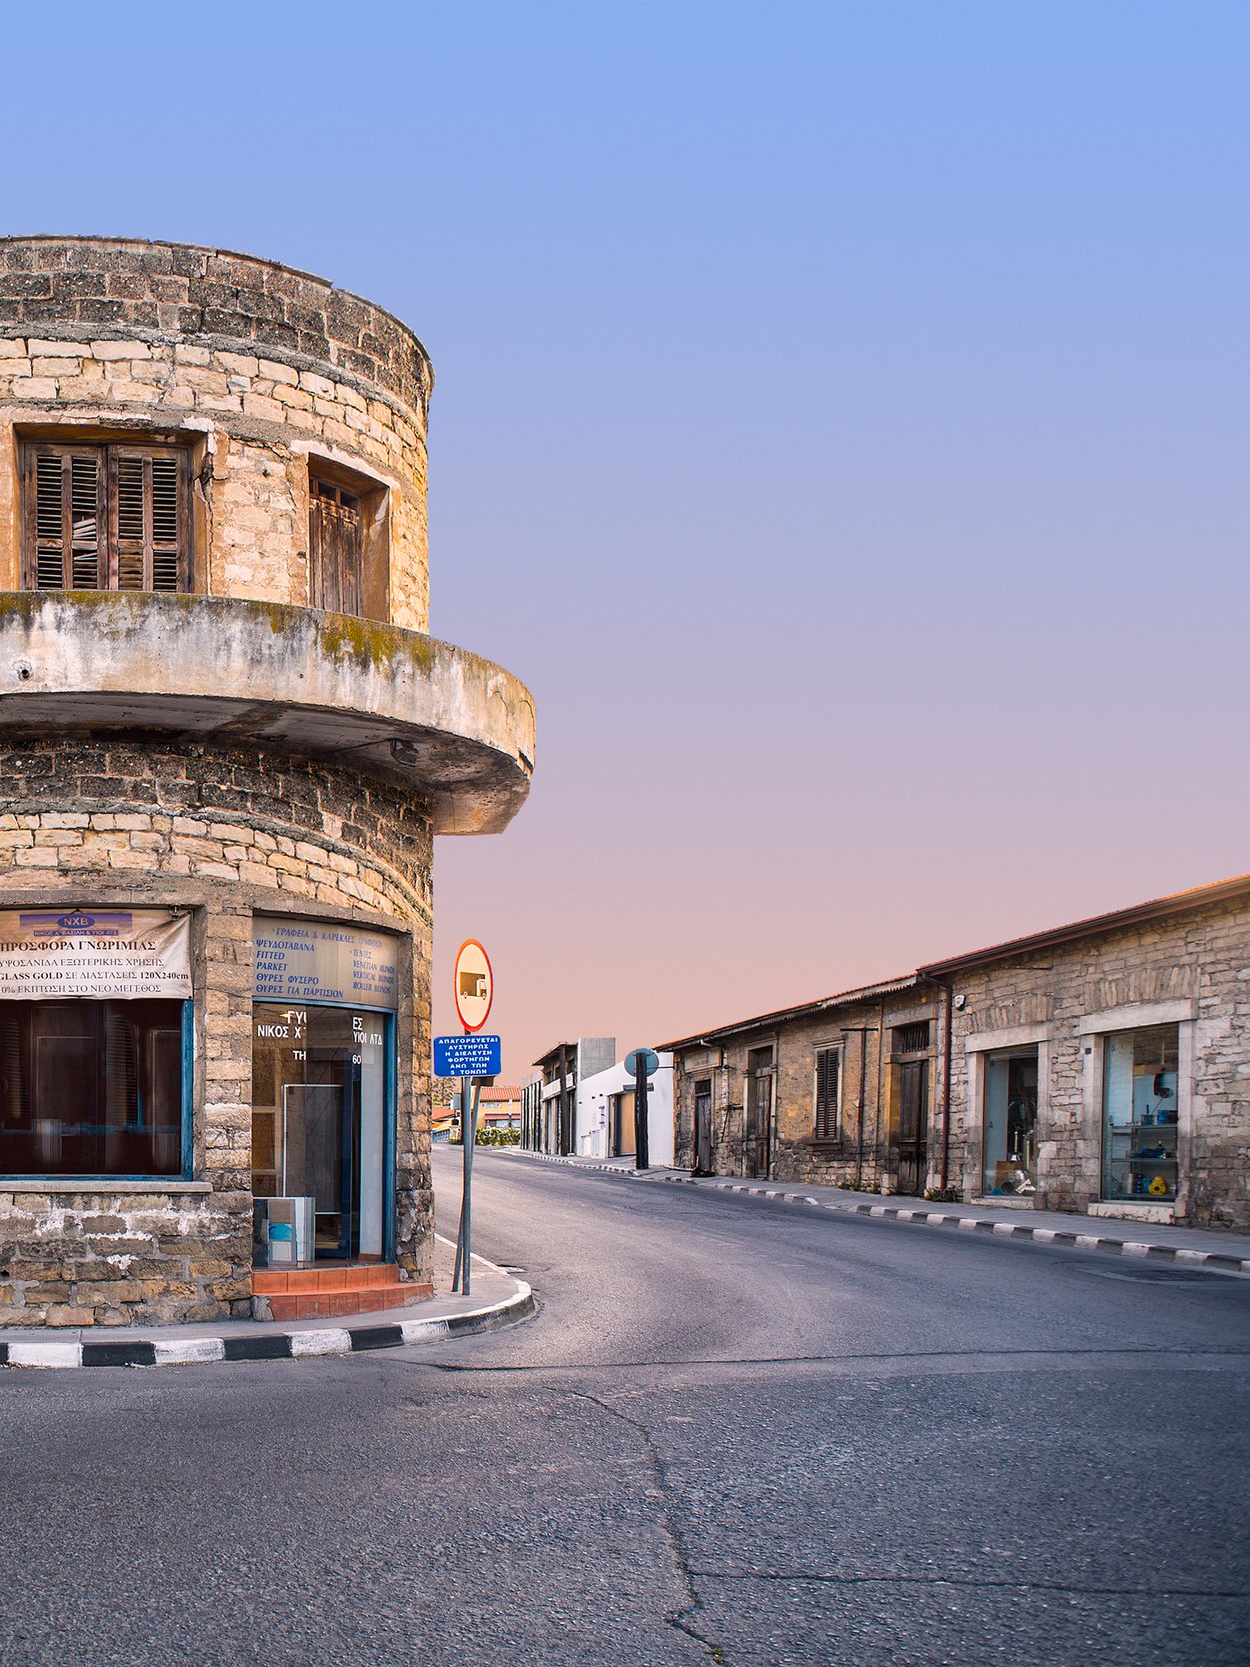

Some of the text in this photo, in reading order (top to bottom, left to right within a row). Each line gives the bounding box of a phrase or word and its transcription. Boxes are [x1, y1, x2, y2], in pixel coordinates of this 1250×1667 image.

[276, 928, 309, 938] ΓΡΑΦΕΙΑ
[313, 931, 318, 939] &
[0, 940, 156, 952] ΠΡΟΣΦΟΡΑ ΓΝΩΡΙΜΙΑΣ
[256, 939, 315, 951] ΨΕΥΔΟΤΑΒΑΝΑ
[256, 950, 285, 960] FITTED
[60, 958, 123, 966] ΕΞΩΤΕΡΙΚΗΣ
[126, 958, 165, 967] ΧΡΗΣΗΣ
[256, 961, 288, 971] PARKET
[32, 971, 63, 980] GOLD
[65, 971, 78, 979] ΣΕ
[79, 971, 138, 979] ΔΙΑΣΤΑΣΕΙΣ
[256, 972, 319, 985] ΘΥΡΕΣ ΦΥΣΕΡΟ
[17, 985, 65, 993] ΕΚΠΤΩΣΗ
[68, 985, 88, 993] ΣΤΟ
[90, 984, 111, 992] ΝΕΟ
[114, 984, 162, 993] ΜΕΓΕΘΟΣ
[256, 984, 344, 998] ΘΥΡΕΣ ΓΙΑ ΠΑΡΤΙΣΙΟΝ
[257, 1024, 289, 1038] ΝΙΚΟΣ
[353, 1031, 367, 1044] ΥΙΟΙ
[369, 1033, 383, 1045] ΛΤΔ
